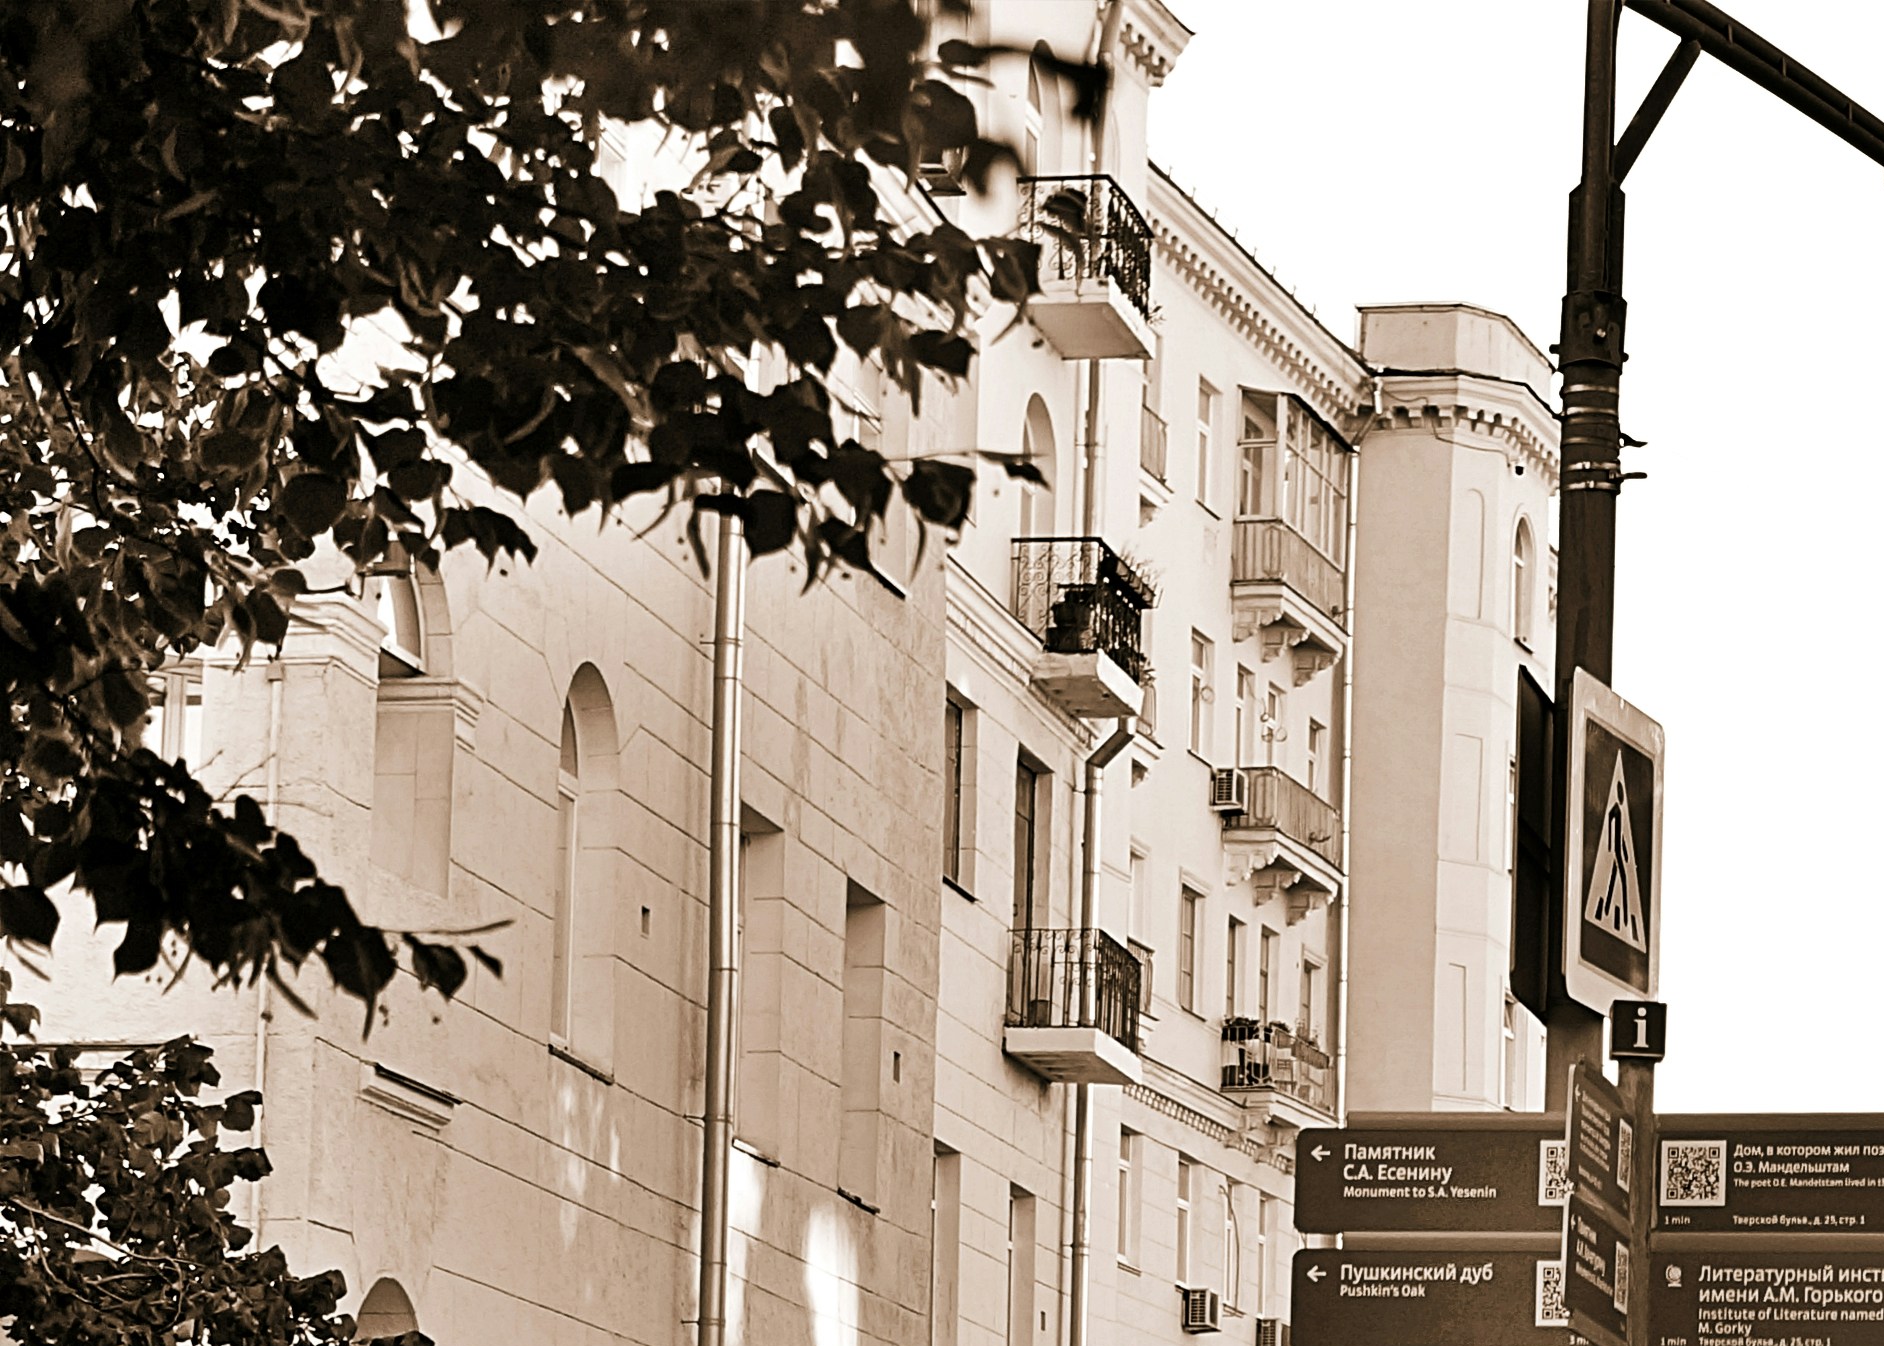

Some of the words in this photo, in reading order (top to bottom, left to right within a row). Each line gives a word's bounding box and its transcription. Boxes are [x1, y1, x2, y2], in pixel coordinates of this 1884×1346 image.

[1344, 1143, 1436, 1161] Памятник
[1734, 1144, 1764, 1159] Дом,
[1767, 1147, 1773, 1156] в
[1776, 1147, 1831, 1159] котором
[1834, 1147, 1860, 1156] жил
[1343, 1164, 1373, 1180] С.А.
[1377, 1165, 1452, 1184] Есенину
[1734, 1161, 1756, 1173] О.Э.
[1758, 1161, 1850, 1175] Мандельштам
[1734, 1178, 1750, 1187] The
[1751, 1179, 1770, 1190] poet
[1789, 1178, 1843, 1187] Mandelstam
[1845, 1178, 1866, 1187] lived
[1867, 1178, 1876, 1187] in
[1343, 1186, 1410, 1198] Monument
[1413, 1187, 1425, 1198] to
[1428, 1187, 1449, 1198] S.A.
[1450, 1187, 1497, 1198] Yesenin
[1665, 1216, 1669, 1225] 1
[1671, 1215, 1690, 1225] min
[1733, 1215, 1778, 1226] Тверской
[1860, 1216, 1865, 1225] 1
[1340, 1264, 1457, 1285] Пушкинский
[1460, 1264, 1493, 1285] дуб
[1699, 1265, 1834, 1285] Литературный
[1402, 1285, 1425, 1298] Oak
[1699, 1287, 1760, 1303] имени
[1763, 1287, 1799, 1303] А.М.
[1804, 1287, 1883, 1306] Горького
[1698, 1308, 1755, 1320] Institute
[1757, 1308, 1772, 1320] of
[1773, 1308, 1838, 1321] Literature
[1840, 1309, 1884, 1321] named
[1698, 1322, 1712, 1334] M.
[1715, 1322, 1752, 1337] Gorky
[1661, 1337, 1665, 1346] 1
[1668, 1337, 1686, 1346] min
[1826, 1337, 1831, 1346] 1
